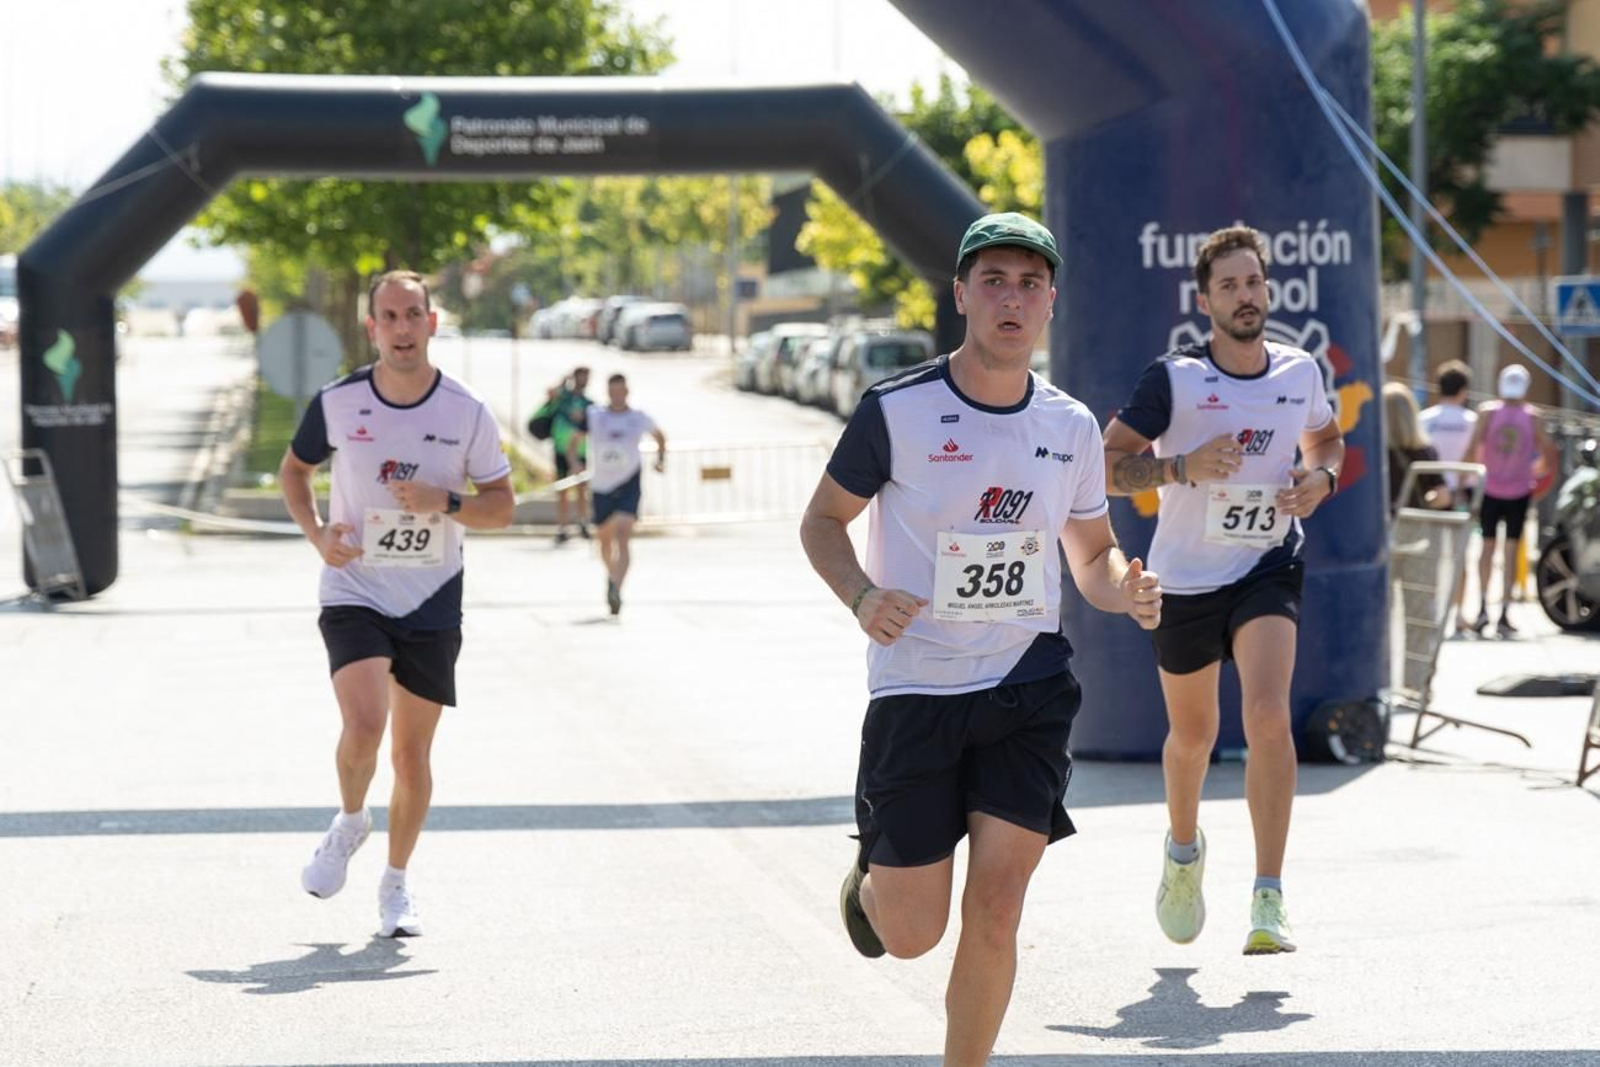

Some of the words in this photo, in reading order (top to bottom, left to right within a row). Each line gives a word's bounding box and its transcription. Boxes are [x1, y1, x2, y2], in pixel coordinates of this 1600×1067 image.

[451, 116, 534, 136] Patronato
[538, 115, 621, 137] Municipal
[625, 115, 648, 135] de
[451, 136, 530, 156] Deportes
[533, 136, 558, 154] de
[928, 453, 974, 463] Santander
[1222, 505, 1276, 531] 513
[377, 527, 431, 552] 439
[956, 560, 1026, 599] 358
